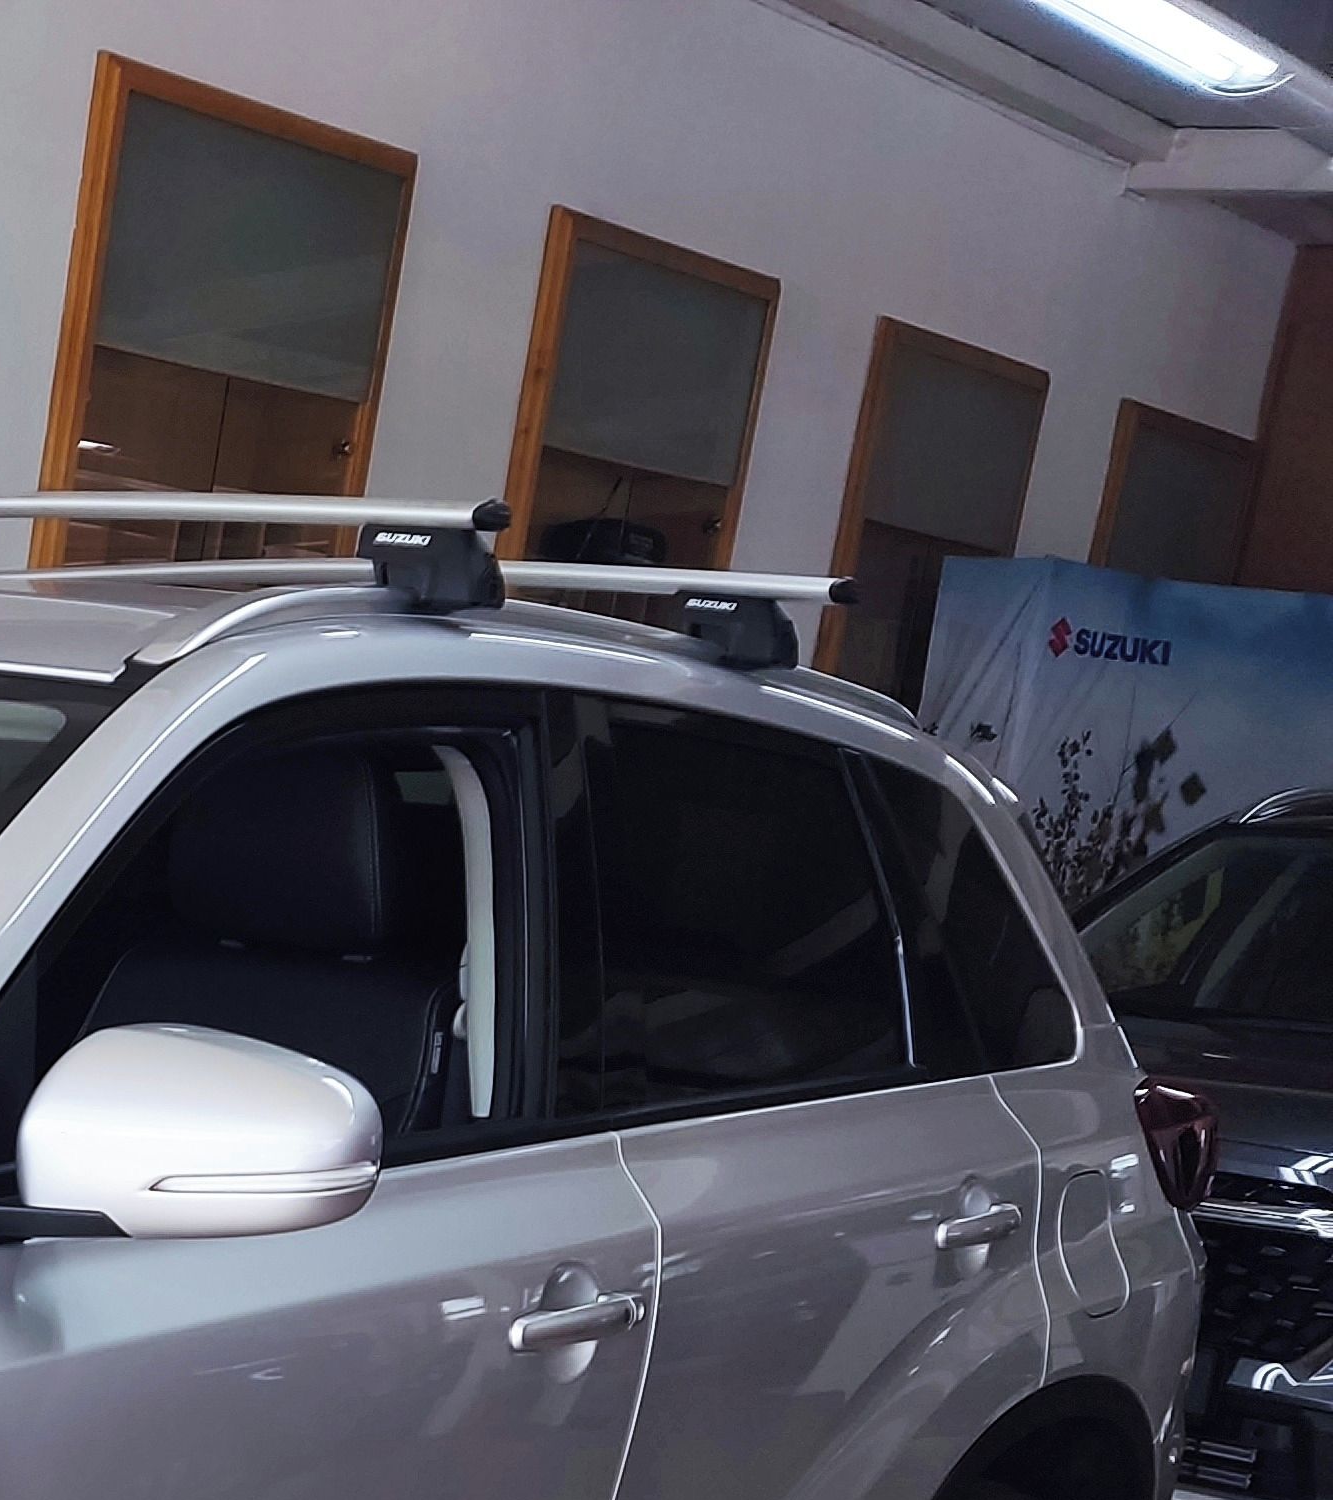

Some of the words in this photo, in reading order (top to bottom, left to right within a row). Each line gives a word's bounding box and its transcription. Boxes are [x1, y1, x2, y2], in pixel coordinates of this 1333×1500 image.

[374, 532, 432, 547] SUZUKI
[685, 598, 738, 611] SUZUKI
[1074, 628, 1172, 666] SUZUKI
